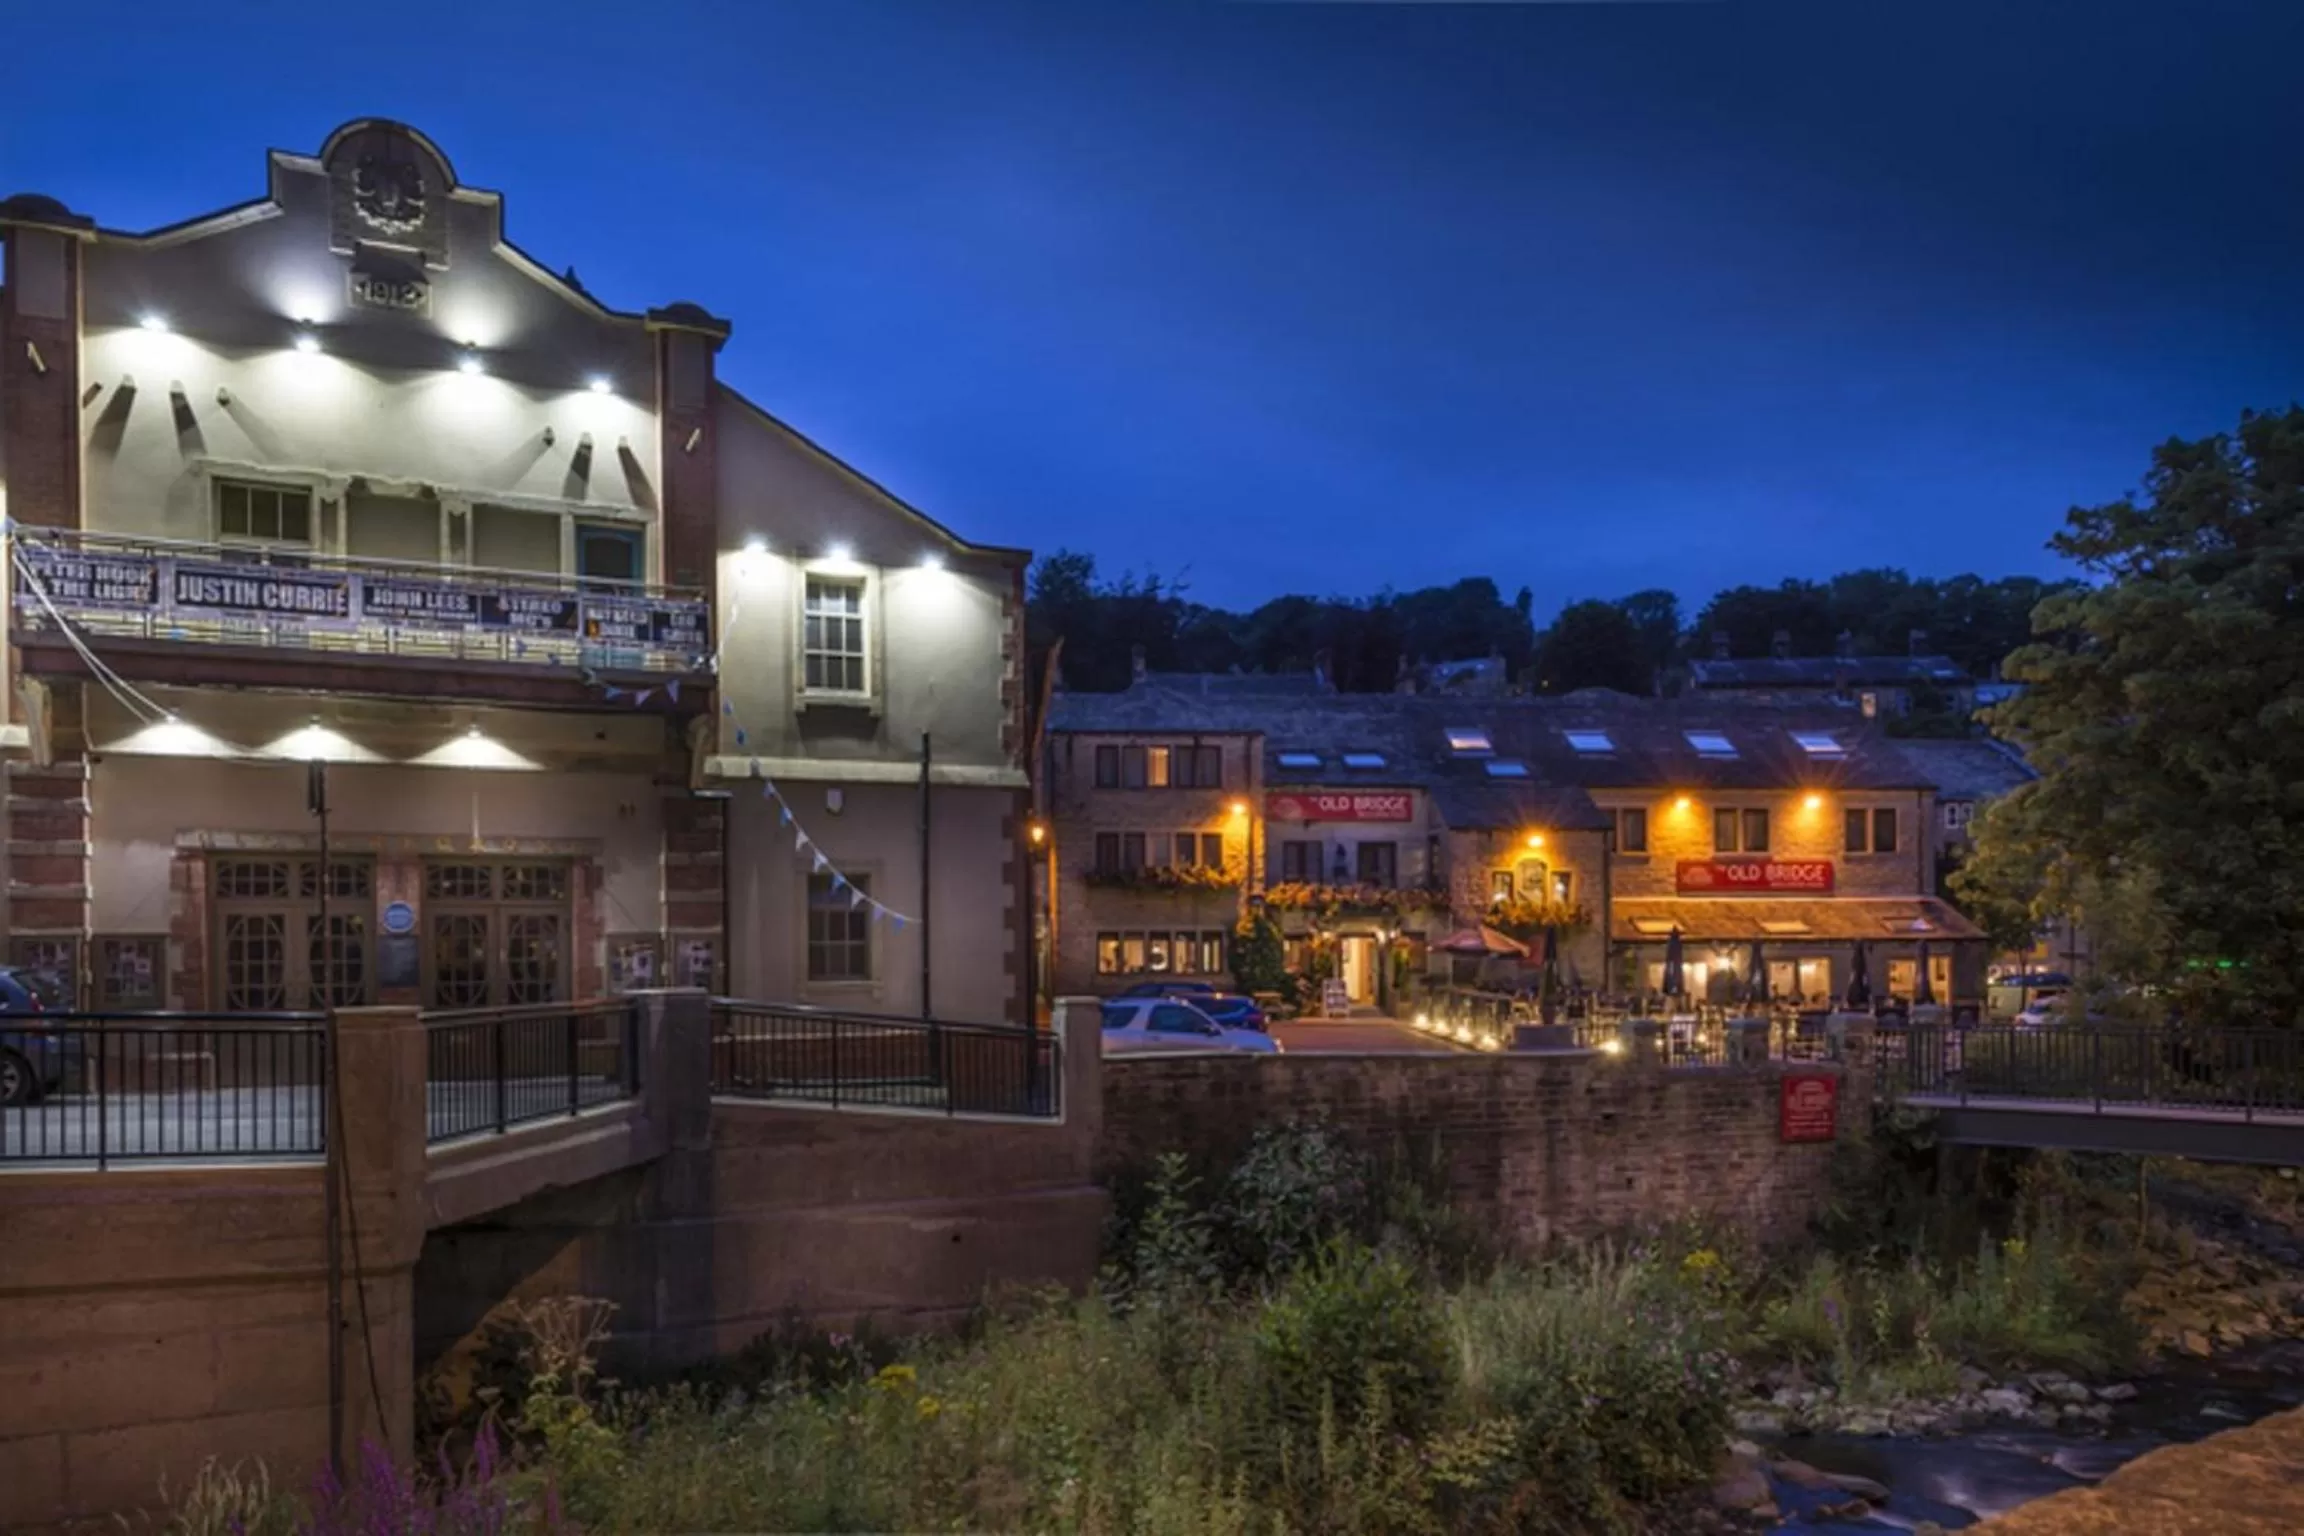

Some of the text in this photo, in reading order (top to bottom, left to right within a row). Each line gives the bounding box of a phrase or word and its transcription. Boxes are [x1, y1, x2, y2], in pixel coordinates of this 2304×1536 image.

[177, 574, 259, 606] JUSTIN
[263, 582, 347, 614] CURRIE
[1319, 796, 1350, 811] OLD
[1353, 796, 1407, 811] BRIDGE
[1727, 864, 1825, 882] OLD BRIDGE
